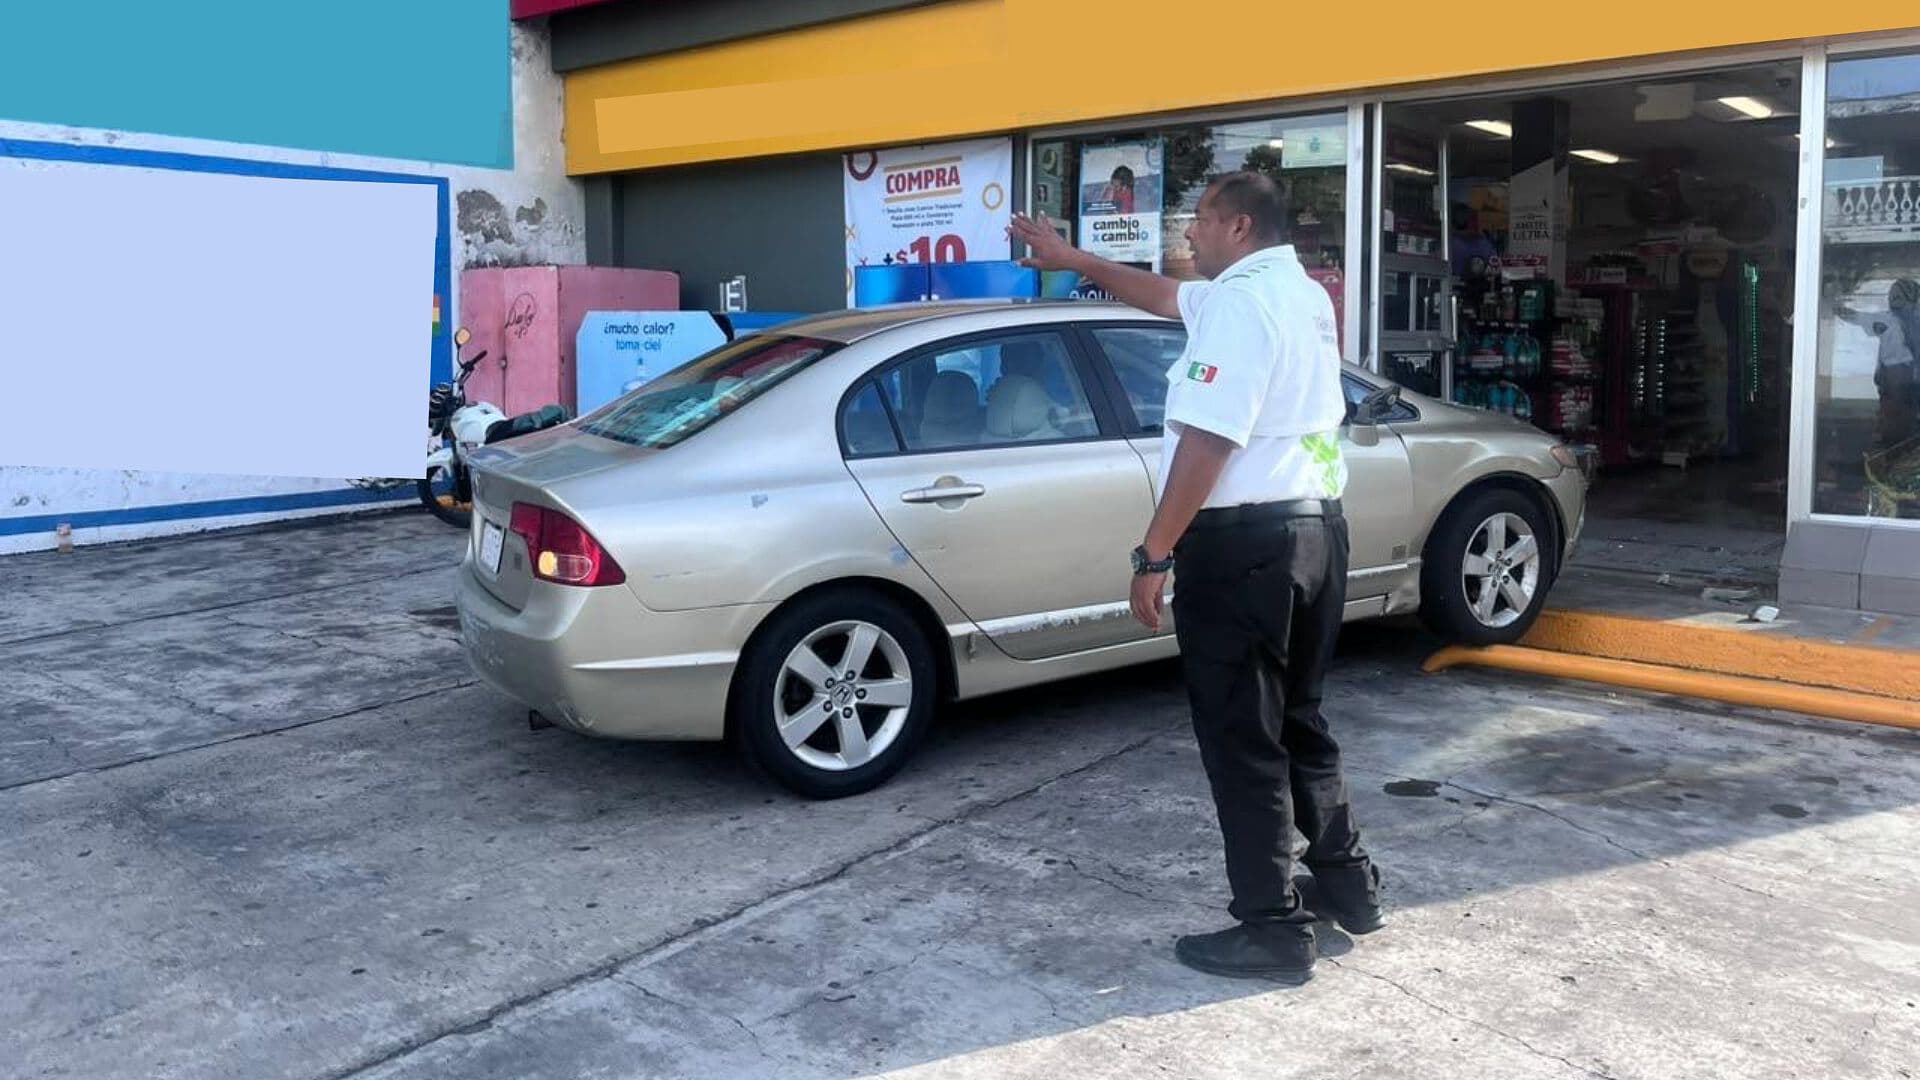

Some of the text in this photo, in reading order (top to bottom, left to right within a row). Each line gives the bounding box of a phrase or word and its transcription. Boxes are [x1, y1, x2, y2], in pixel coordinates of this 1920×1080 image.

[886, 165, 961, 194] COMPRA
[1093, 216, 1139, 231] cambio
[1102, 229, 1148, 242] cambio
[604, 321, 675, 335] ¿mucho calor?
[616, 338, 662, 351] toma ciel
